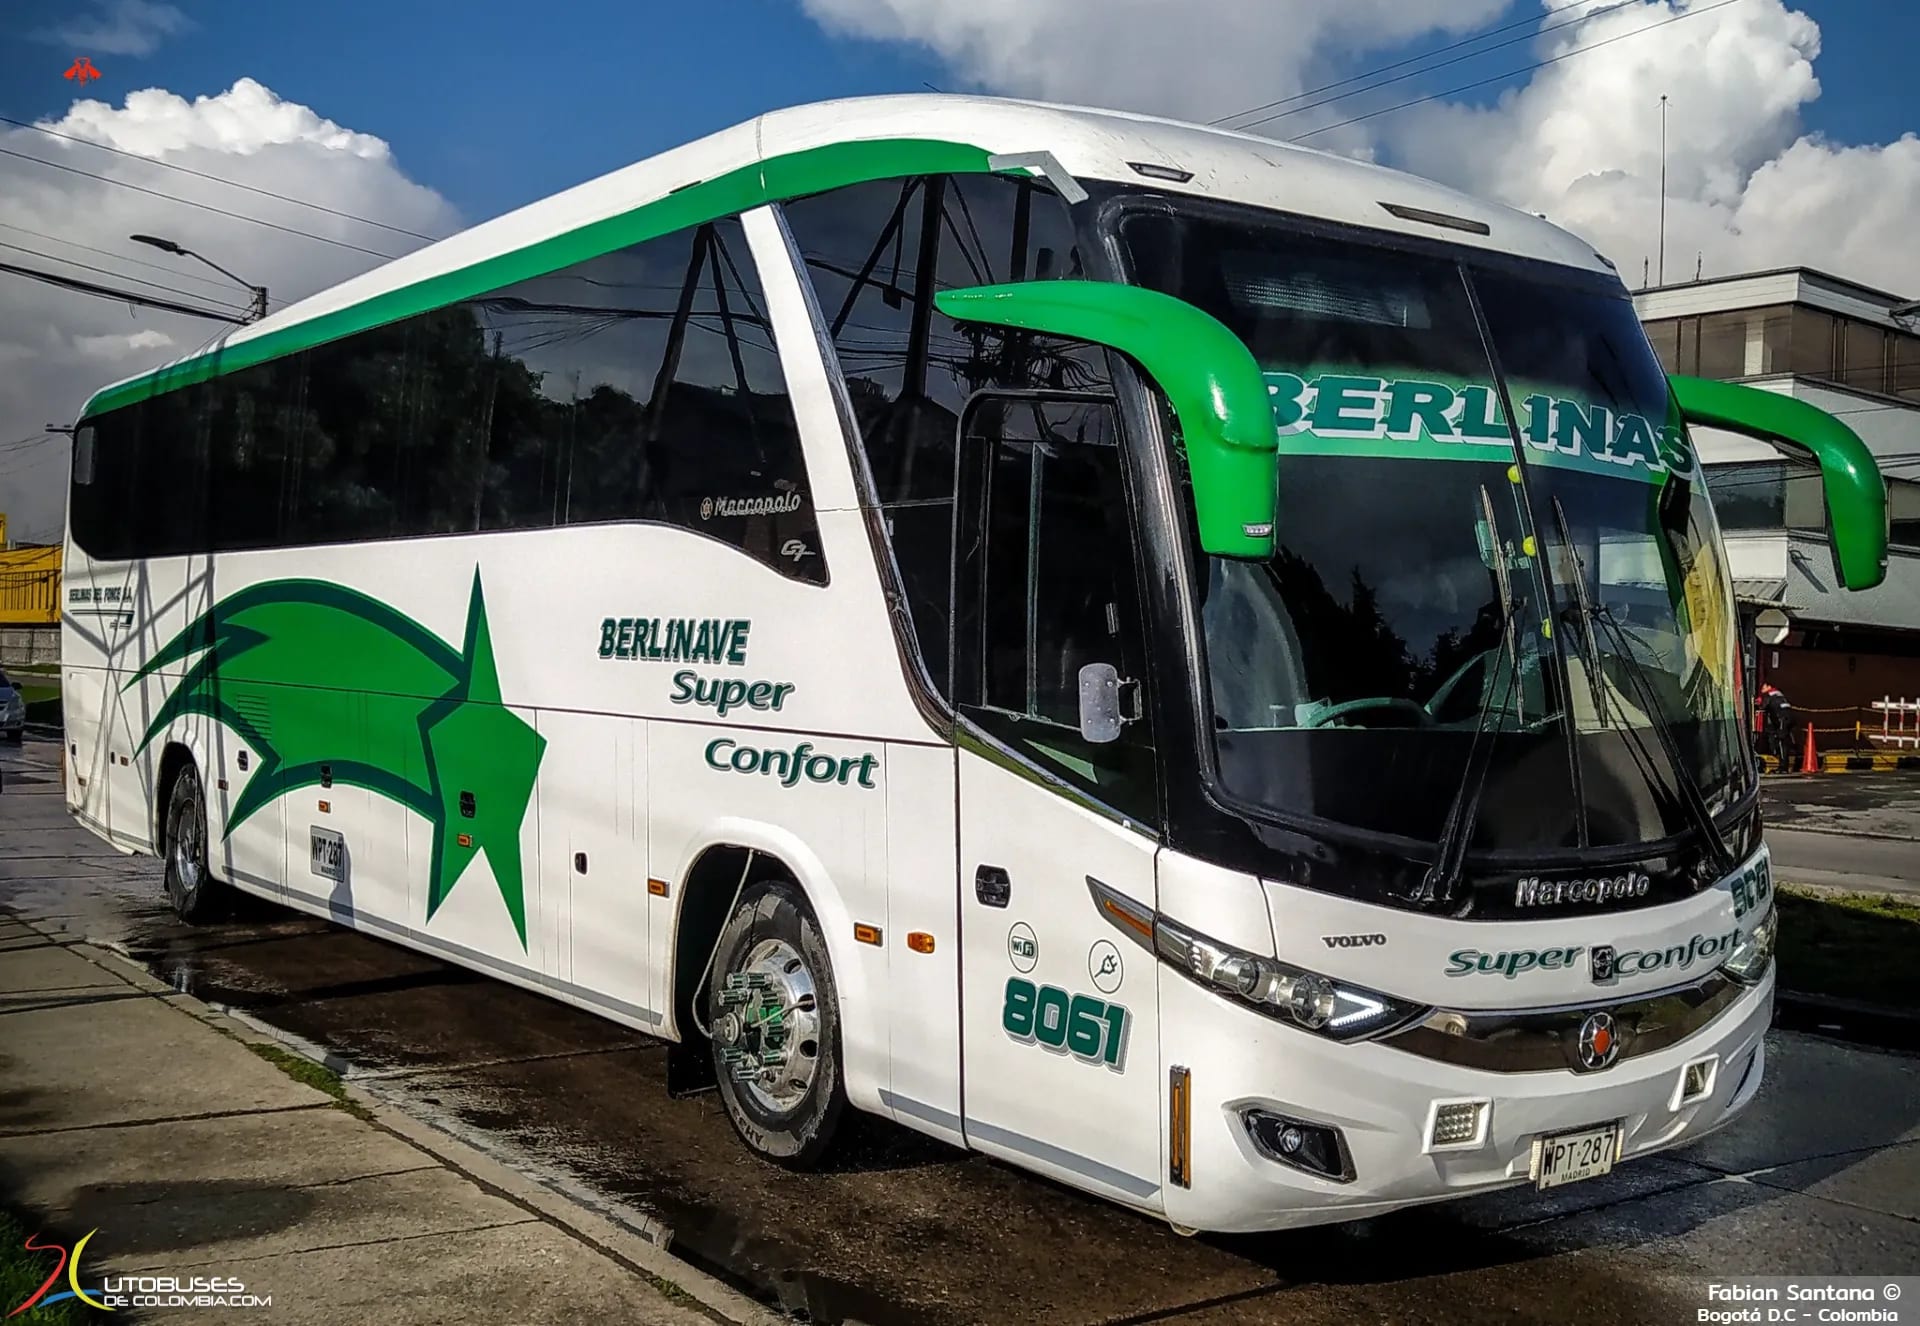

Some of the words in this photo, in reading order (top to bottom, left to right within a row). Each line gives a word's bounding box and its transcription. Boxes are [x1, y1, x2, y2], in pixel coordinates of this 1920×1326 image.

[1262, 372, 1697, 480] BERLINAS
[598, 617, 750, 665] BERLINAVE
[669, 669, 795, 717] Super
[704, 738, 879, 789] Confort
[1515, 871, 1649, 908] Marcopolo
[1322, 934, 1387, 948] VOLVO
[1443, 945, 1586, 979] Super
[1613, 928, 1743, 975] Confort
[1002, 976, 1133, 1074] 8061
[1561, 1168, 1591, 1182] MADRID
